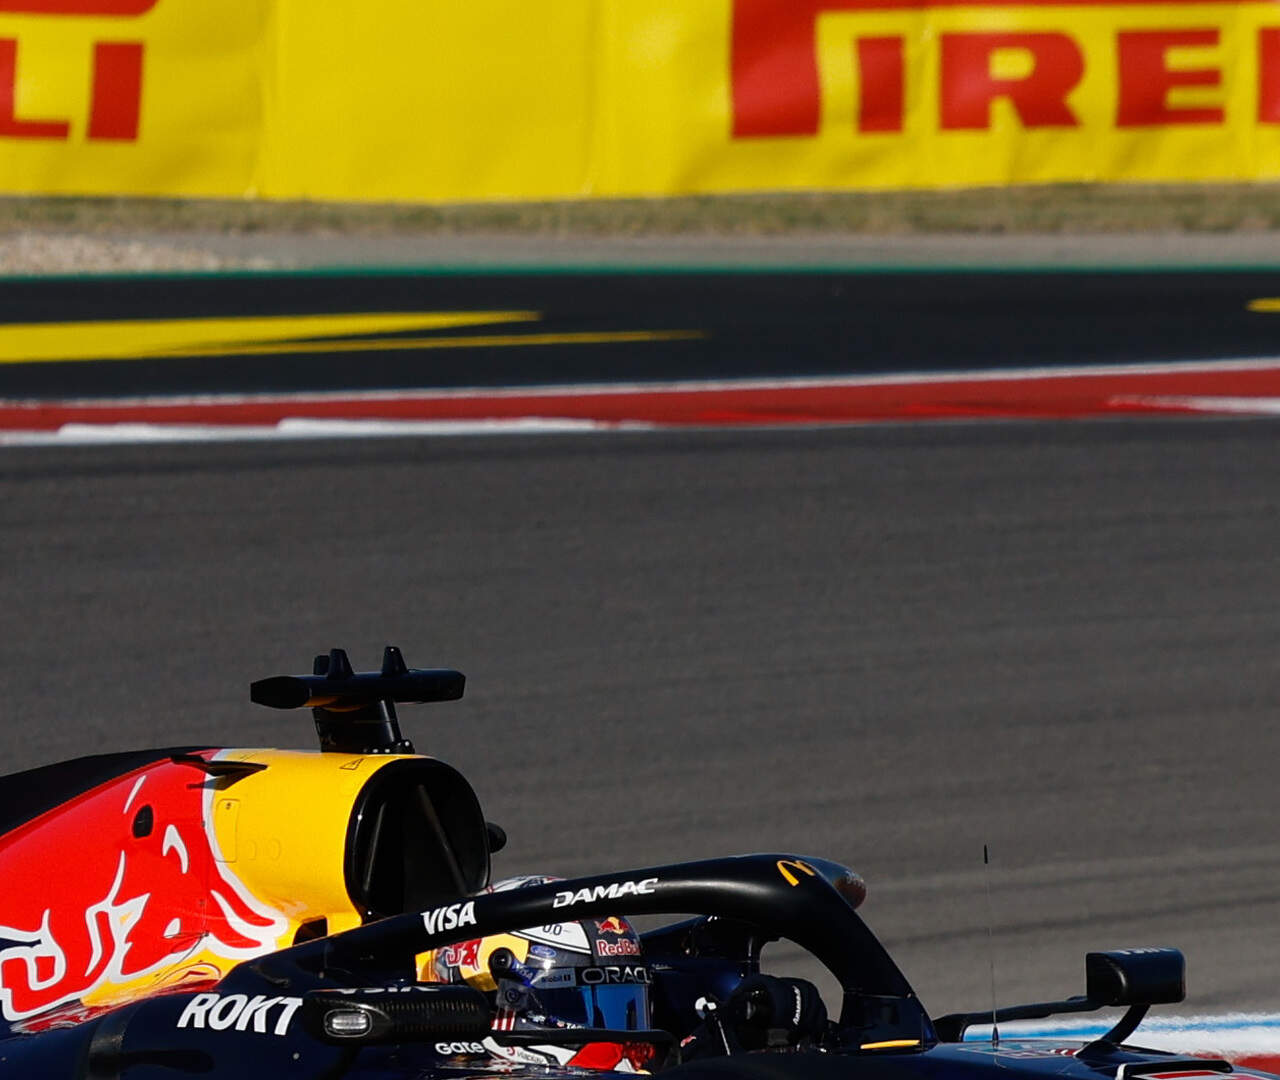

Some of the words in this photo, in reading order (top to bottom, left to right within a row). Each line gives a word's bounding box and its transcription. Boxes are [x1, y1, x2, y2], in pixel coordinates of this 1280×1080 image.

[553, 877, 659, 908] DAMAC
[420, 901, 477, 935] VISA
[176, 994, 303, 1036] ROKT
[435, 1041, 485, 1055] Gate
